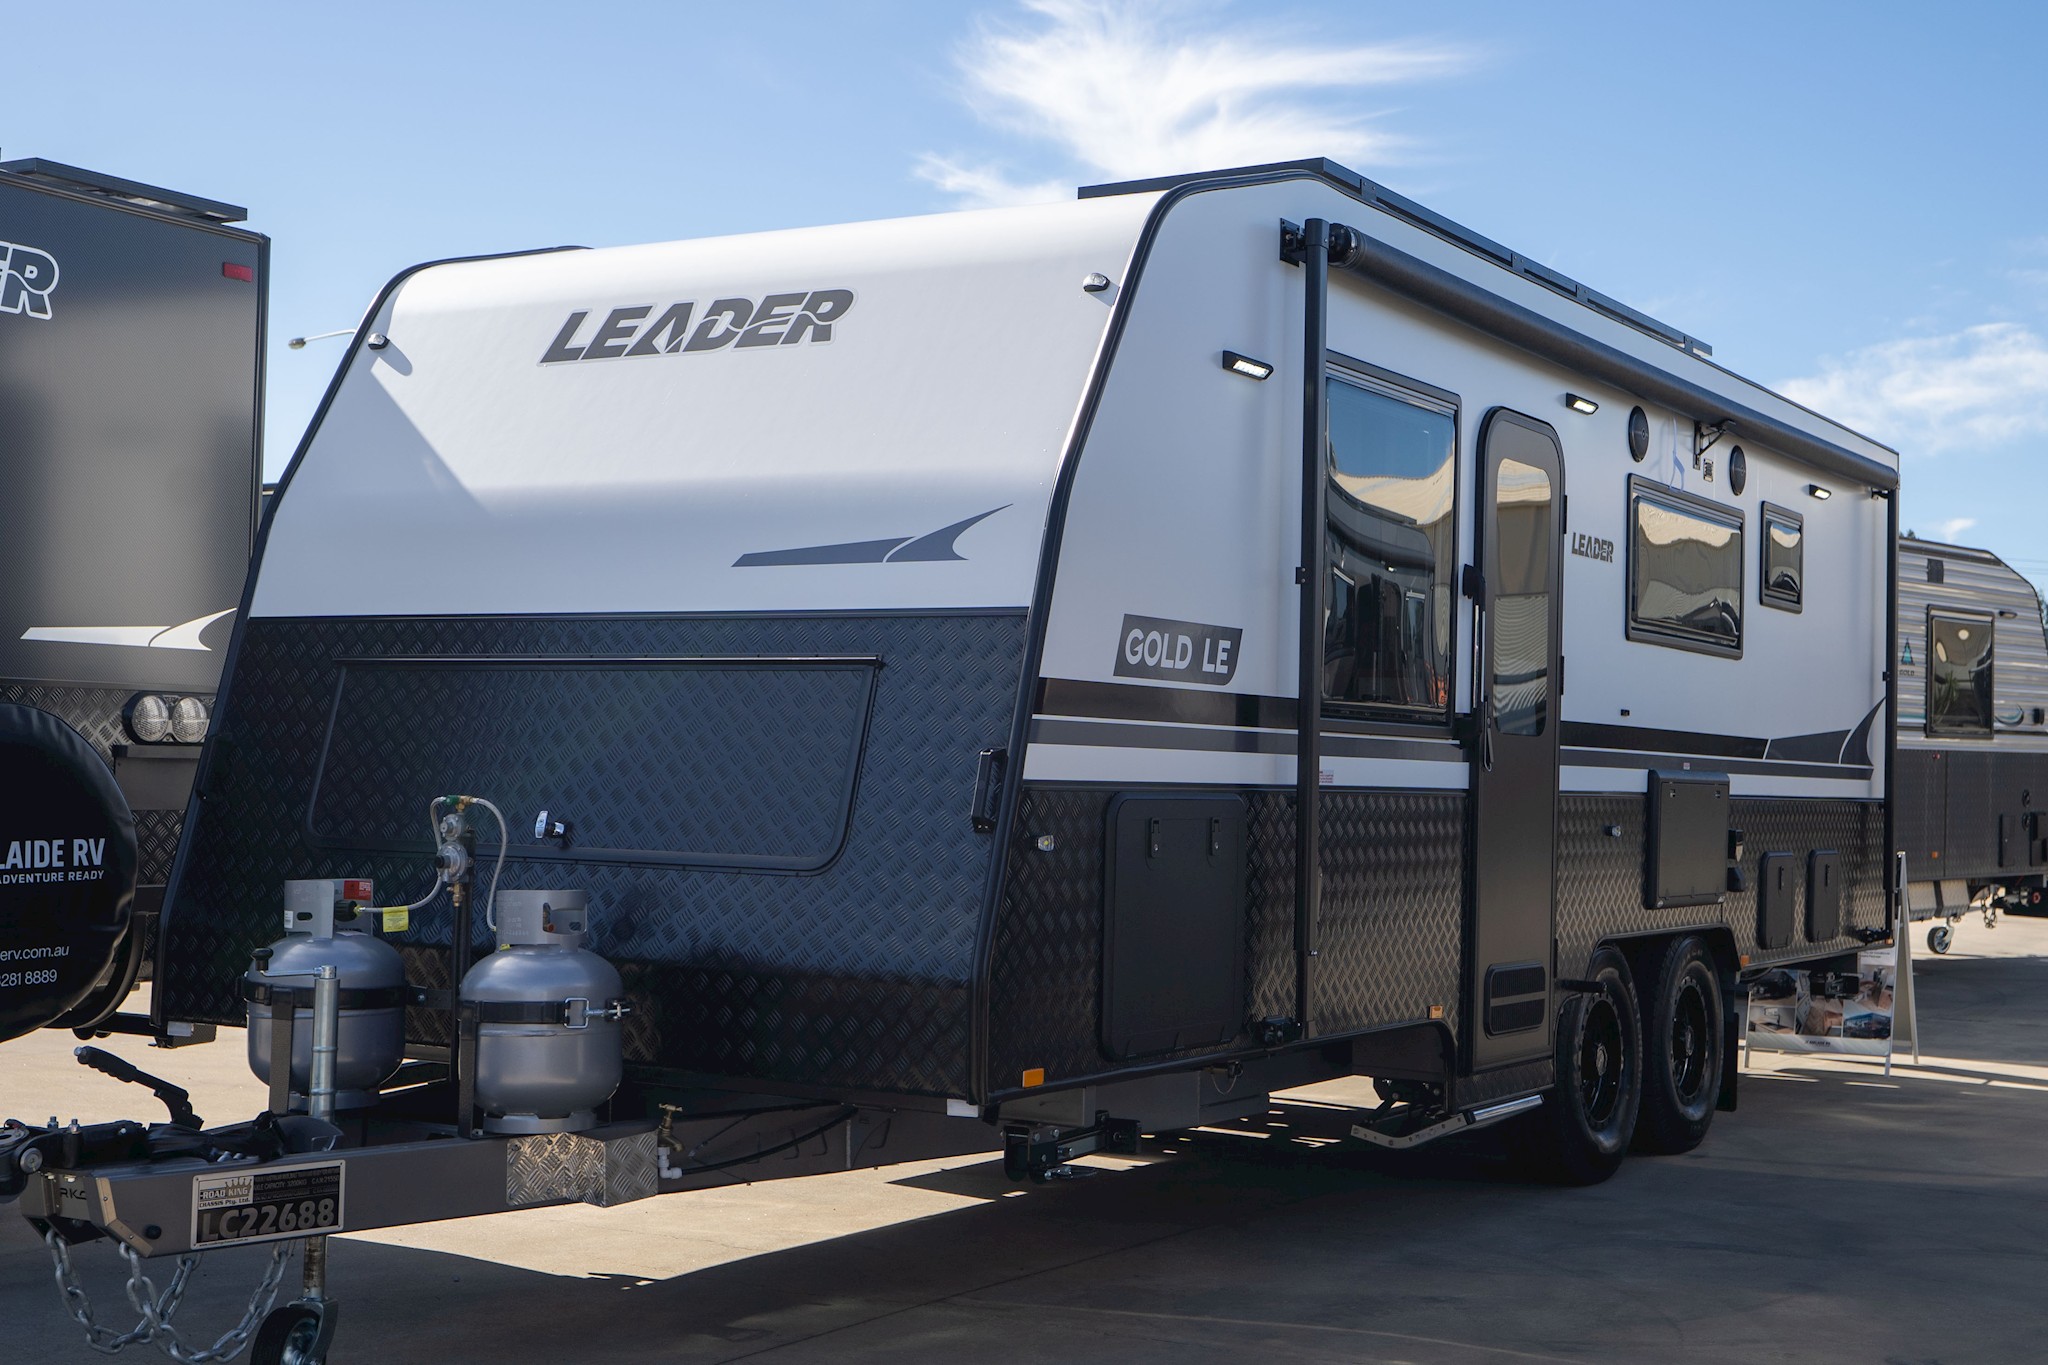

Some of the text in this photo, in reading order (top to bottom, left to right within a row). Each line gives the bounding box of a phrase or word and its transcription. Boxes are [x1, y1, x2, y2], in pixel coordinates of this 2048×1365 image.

[0, 241, 60, 320] R
[539, 288, 855, 364] LEADER
[1571, 532, 1614, 563] LEADER
[1125, 628, 1232, 674] GOLD LE
[0, 838, 106, 869] AIDE RV
[68, 870, 104, 882] READY
[0, 945, 70, 961] erv.com.au
[0, 969, 58, 987] 281 8889
[200, 1200, 224, 1208] CHASSIS
[203, 1189, 226, 1199] ROAD
[228, 1187, 248, 1196] KING
[201, 1197, 335, 1242] LC22688
